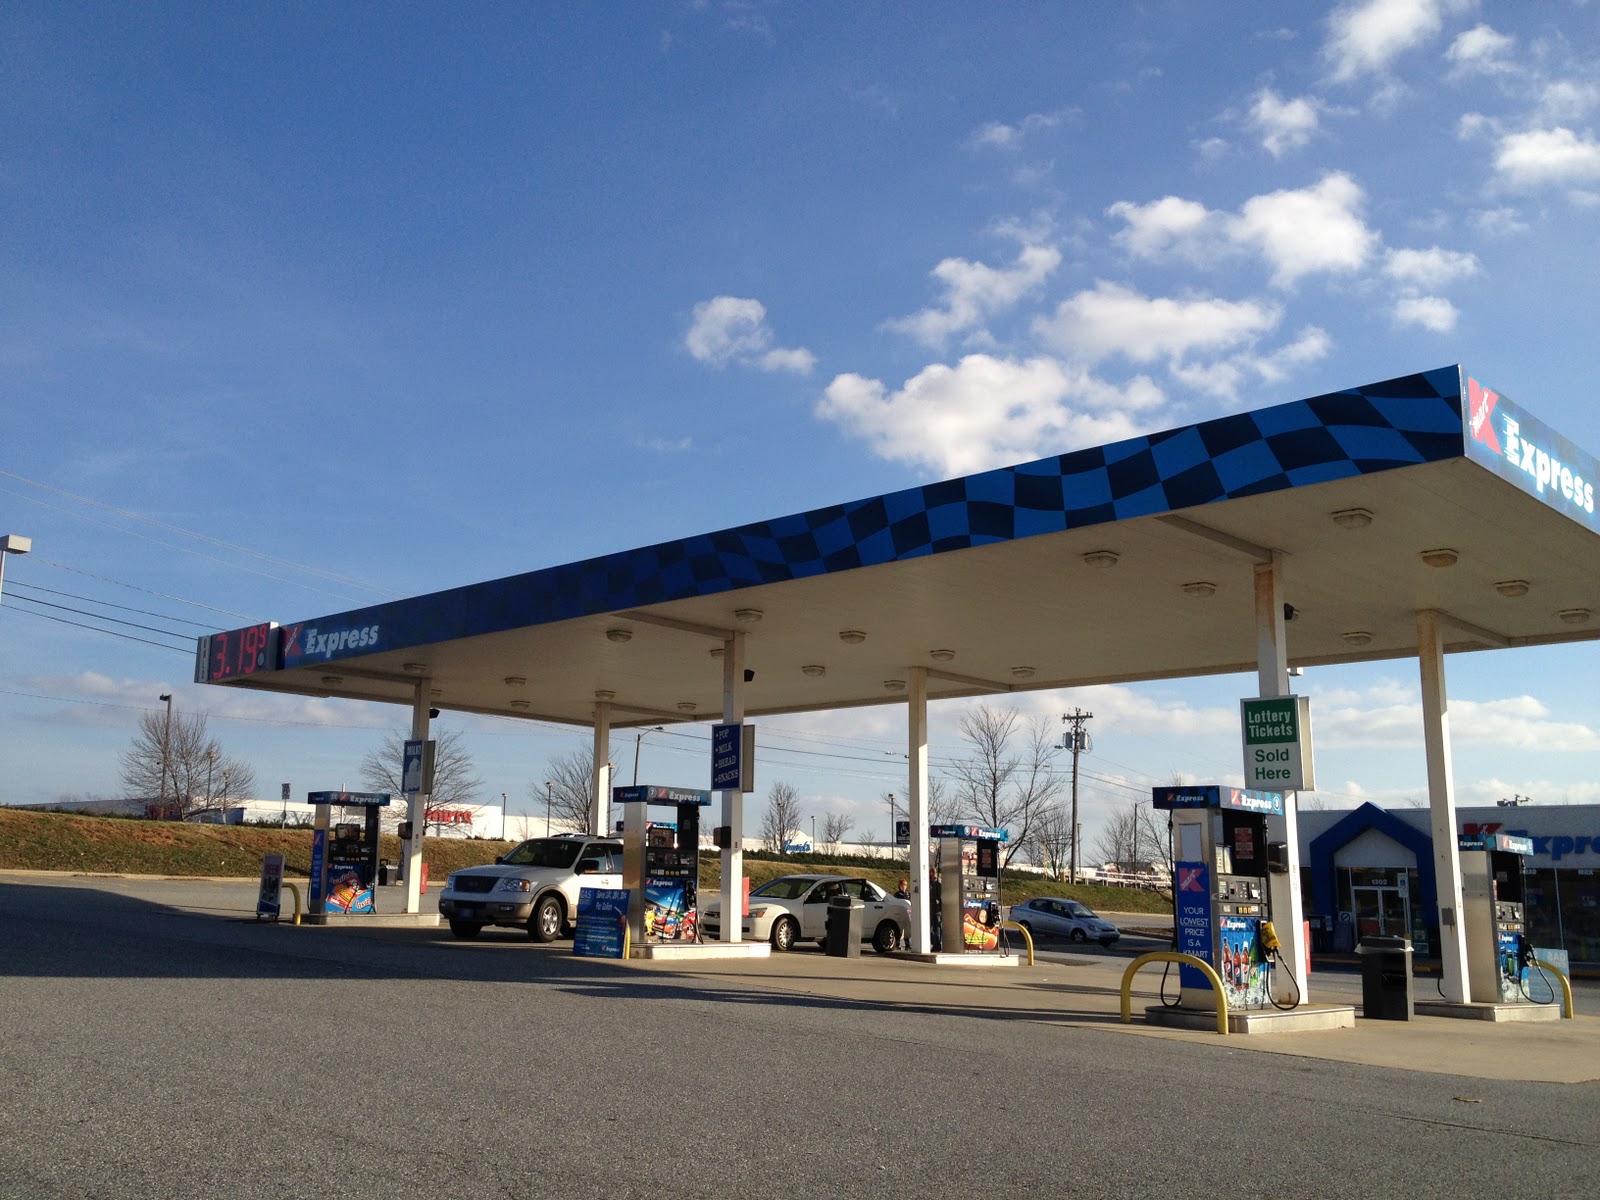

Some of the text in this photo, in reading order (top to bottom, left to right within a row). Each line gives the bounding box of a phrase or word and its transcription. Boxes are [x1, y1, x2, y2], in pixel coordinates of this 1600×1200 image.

[1502, 413, 1594, 513] Express
[305, 625, 379, 657] Express
[1248, 711, 1291, 724] Lottery
[1249, 725, 1293, 738] Tickets
[1255, 748, 1289, 763] Sold
[1255, 767, 1291, 780] Here
[350, 794, 380, 804] Express
[669, 791, 701, 802] Express
[1176, 794, 1204, 802] Express
[1241, 794, 1272, 810] Express
[979, 829, 1001, 839] Express
[1184, 906, 1205, 915] YOUR
[1180, 917, 1209, 926] LOWEST
[1227, 920, 1246, 929] Express
[1184, 927, 1205, 937] PRICE
[1187, 938, 1201, 947] IS A
[1183, 949, 1209, 959] KMART
